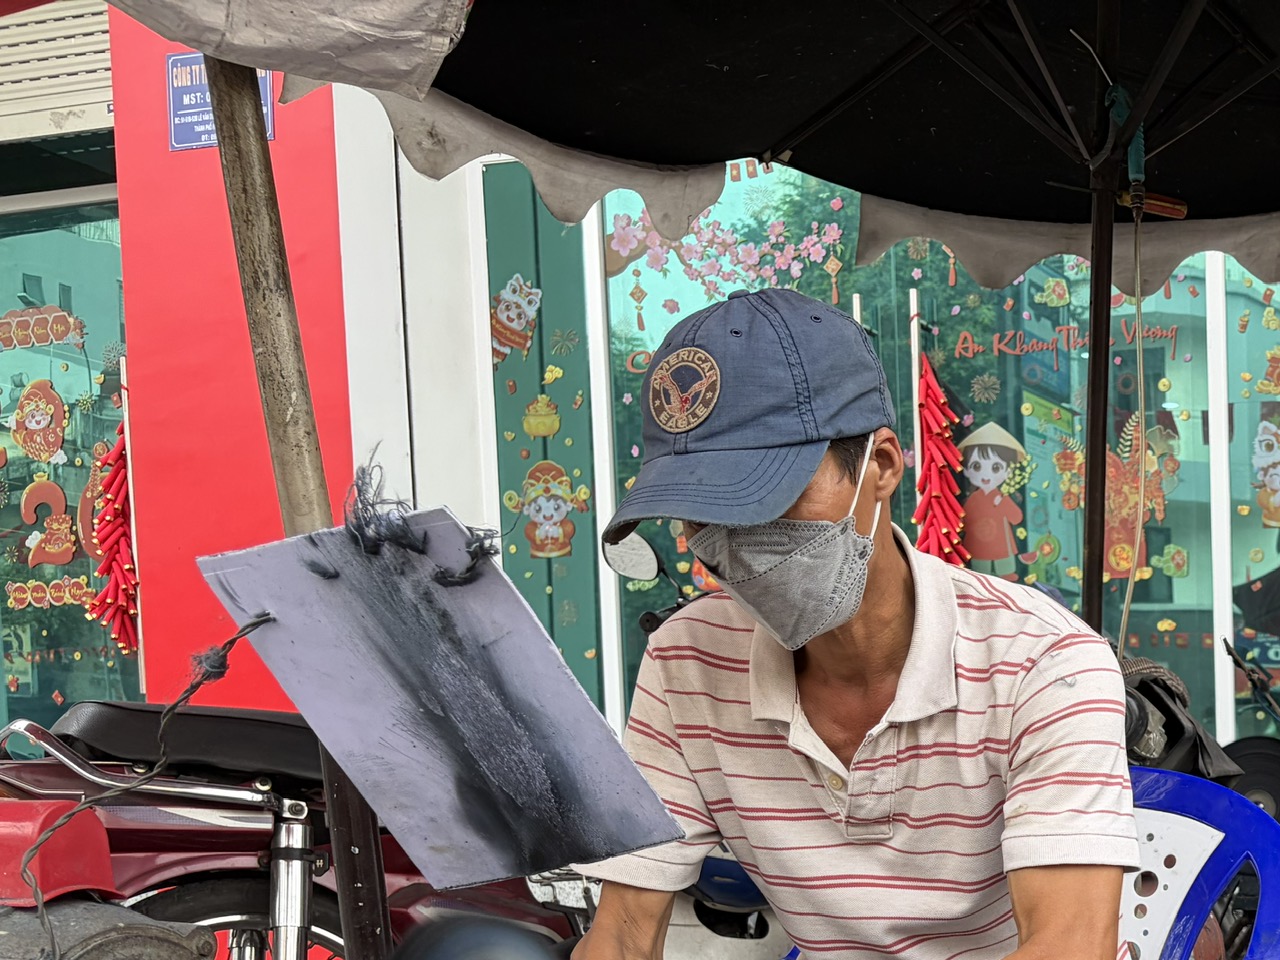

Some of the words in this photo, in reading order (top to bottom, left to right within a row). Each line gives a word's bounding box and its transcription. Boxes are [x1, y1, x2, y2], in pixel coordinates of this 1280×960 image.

[183, 94, 204, 105] MST:
[954, 330, 985, 358] An
[993, 330, 1059, 371] Khang
